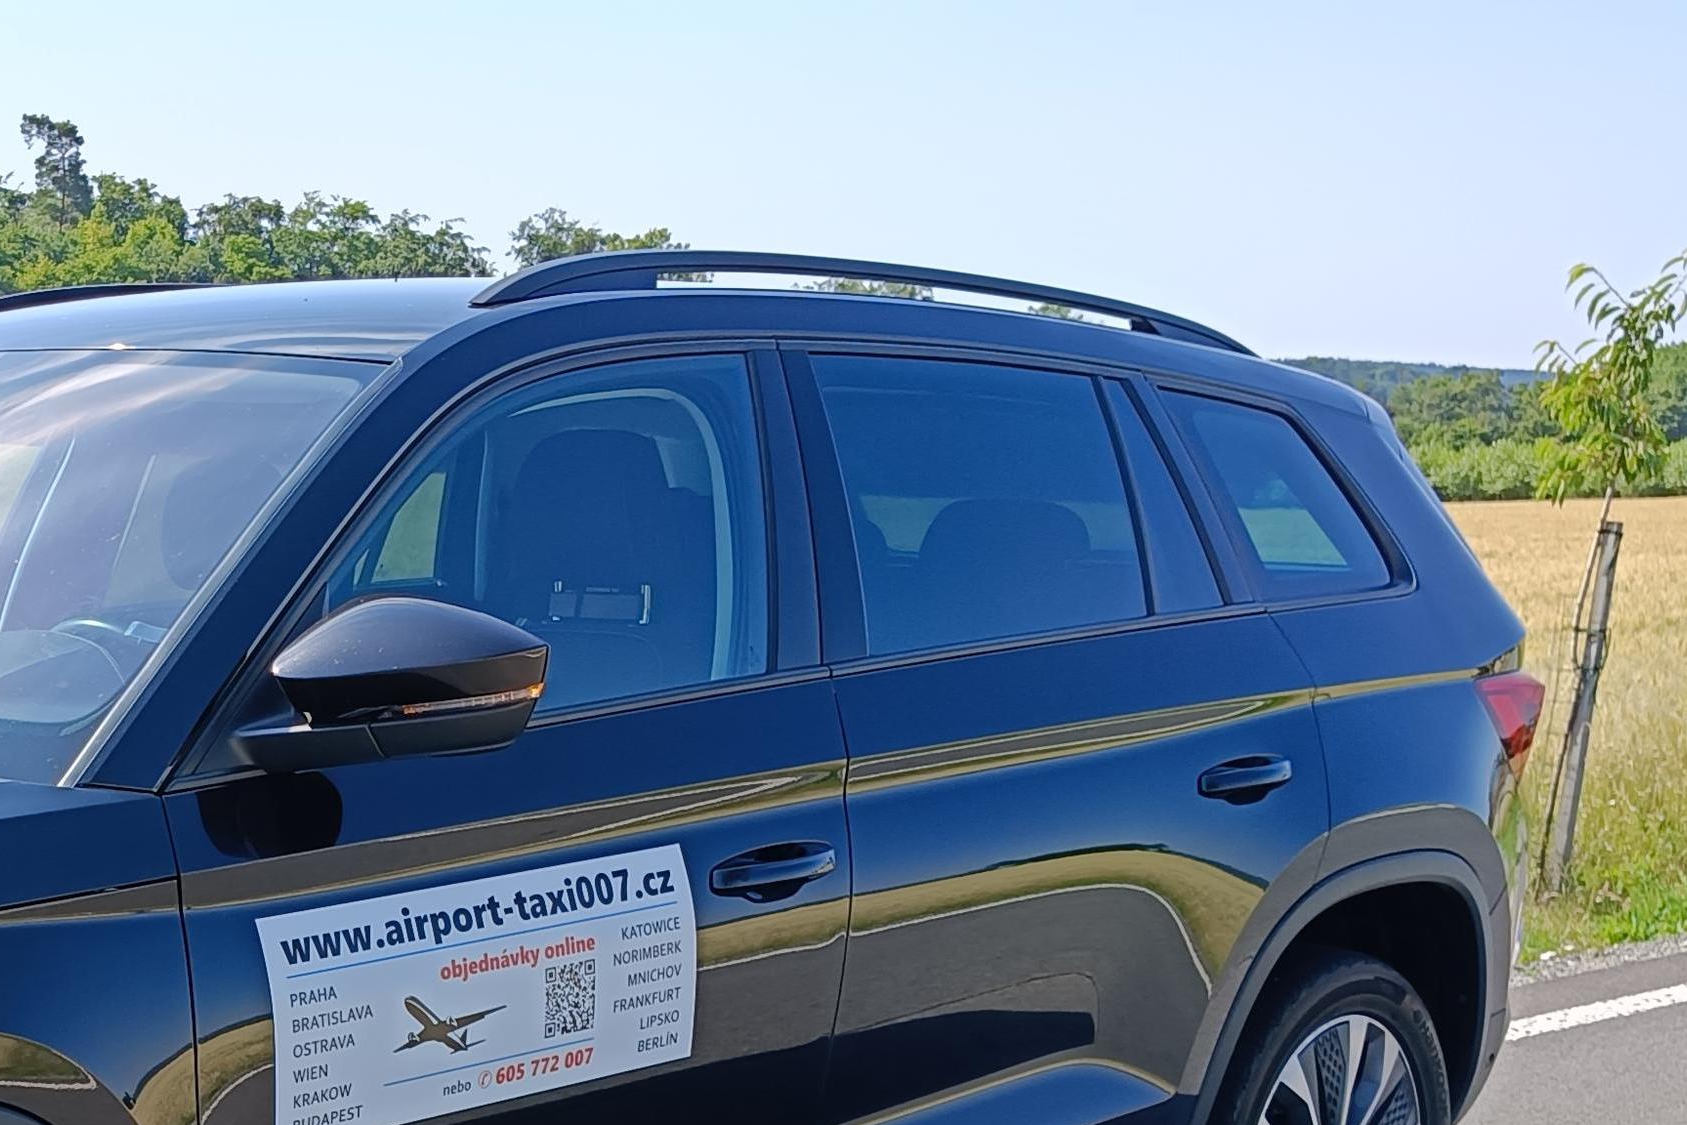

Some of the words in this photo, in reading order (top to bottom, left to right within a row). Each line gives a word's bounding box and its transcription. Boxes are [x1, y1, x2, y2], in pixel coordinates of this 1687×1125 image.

[280, 868, 675, 966] www.airport-taxi007.cz
[620, 916, 681, 941] KATOWICE
[440, 945, 540, 982] objednávky
[544, 936, 596, 960] online
[613, 940, 682, 967] NORIMBERK
[627, 964, 682, 987] MNICHOV
[289, 986, 338, 1008] PRAHA
[613, 987, 681, 1013] FRANKFURT
[292, 1004, 374, 1034] BRATISLAVA
[639, 1009, 680, 1030] LIPSKO
[292, 1033, 355, 1058] OSTRAVA
[637, 1032, 678, 1053] BERLÍN
[292, 1063, 329, 1084] WIEN
[442, 1079, 472, 1097] nebo
[495, 1062, 525, 1085] 605
[530, 1055, 560, 1077] 772
[564, 1047, 594, 1070] 007
[293, 1083, 353, 1109] KRAKOW
